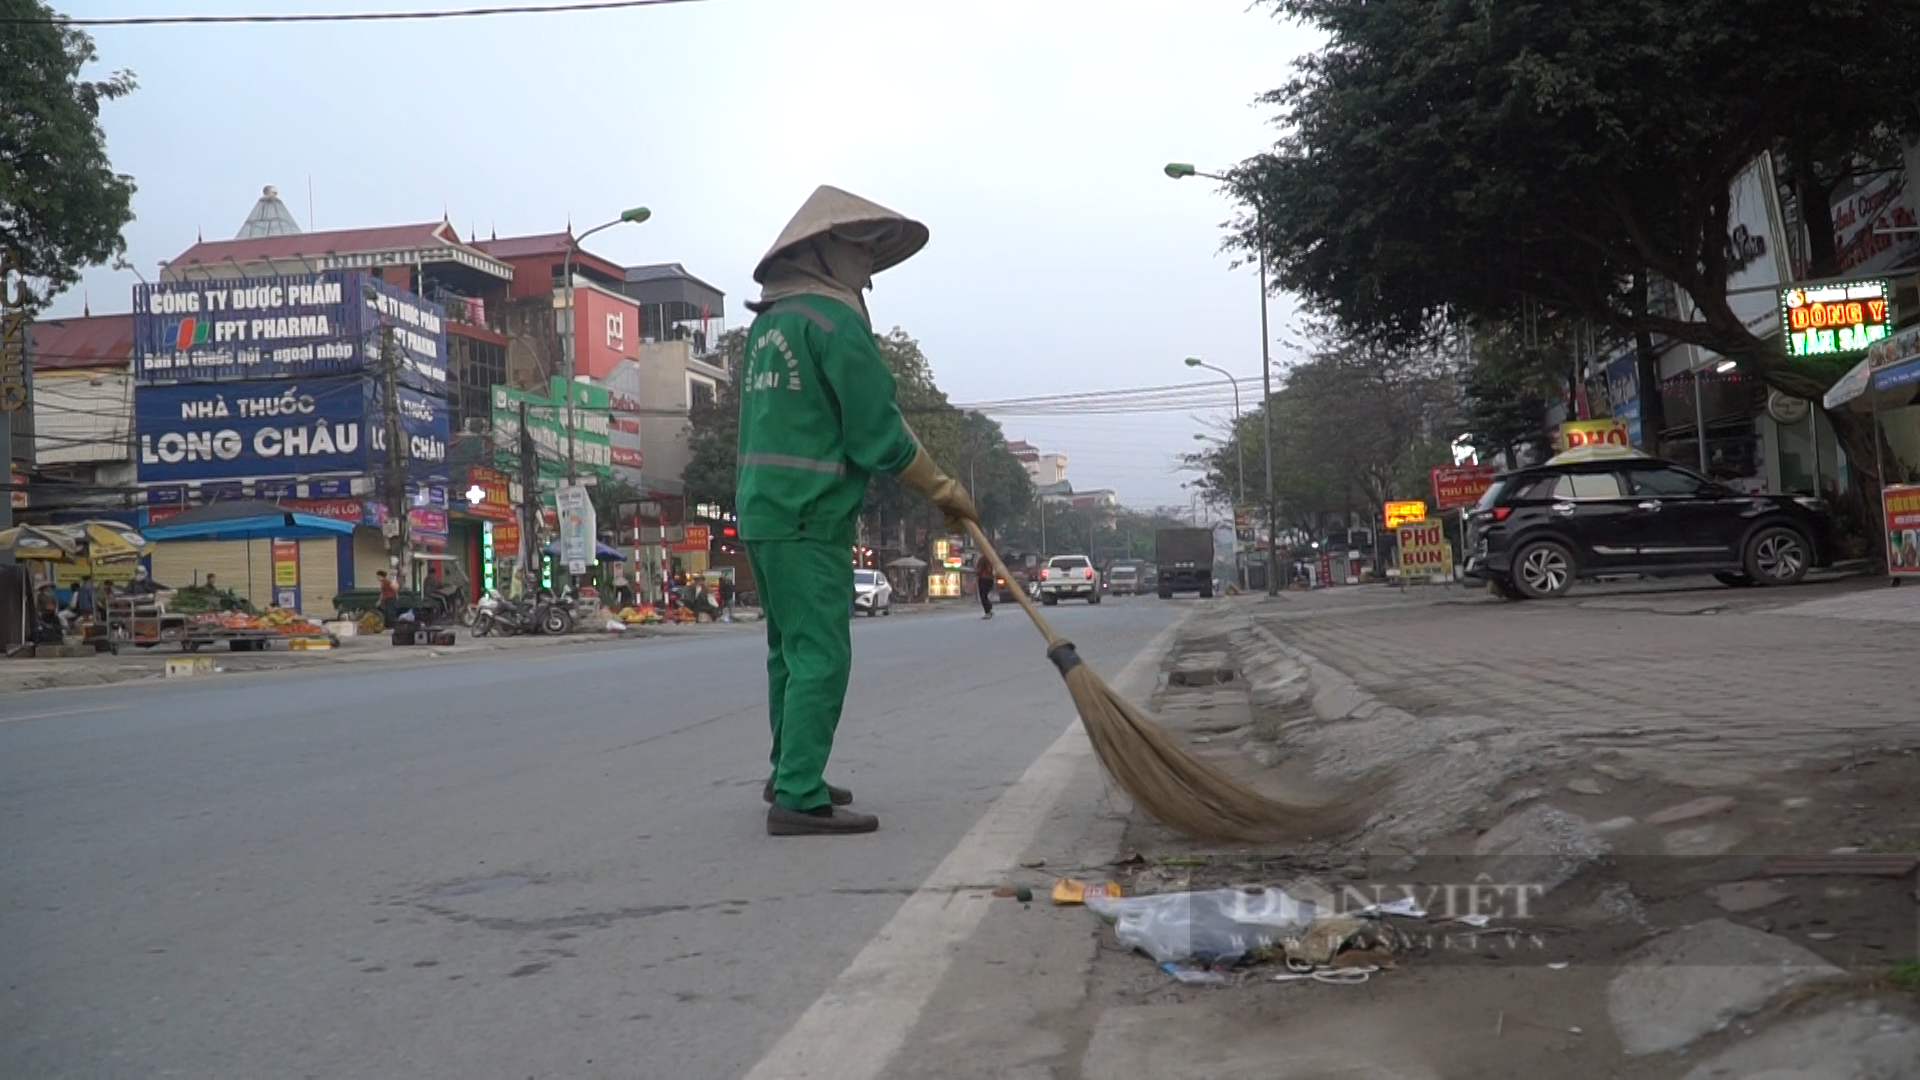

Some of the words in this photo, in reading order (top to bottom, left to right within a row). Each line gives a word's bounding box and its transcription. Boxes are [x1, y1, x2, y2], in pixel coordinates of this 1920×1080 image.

[150, 288, 201, 314] CÔNG
[205, 289, 228, 311] TY
[232, 285, 283, 311] DƯỢC
[288, 276, 341, 306] PHẨM
[215, 320, 247, 344] FPT
[251, 315, 330, 341] PHARMA
[1791, 302, 1863, 328] ĐÔNG
[273, 343, 314, 364] ngoại
[316, 340, 353, 362] nhập
[182, 394, 229, 419] NHÀ
[237, 386, 316, 417] THUỐC
[141, 429, 243, 464] LONG
[254, 418, 358, 458] CHÂU
[411, 435, 445, 462] CHÂU
[1400, 519, 1441, 548] PHỞ
[1403, 549, 1442, 566] BÚN
